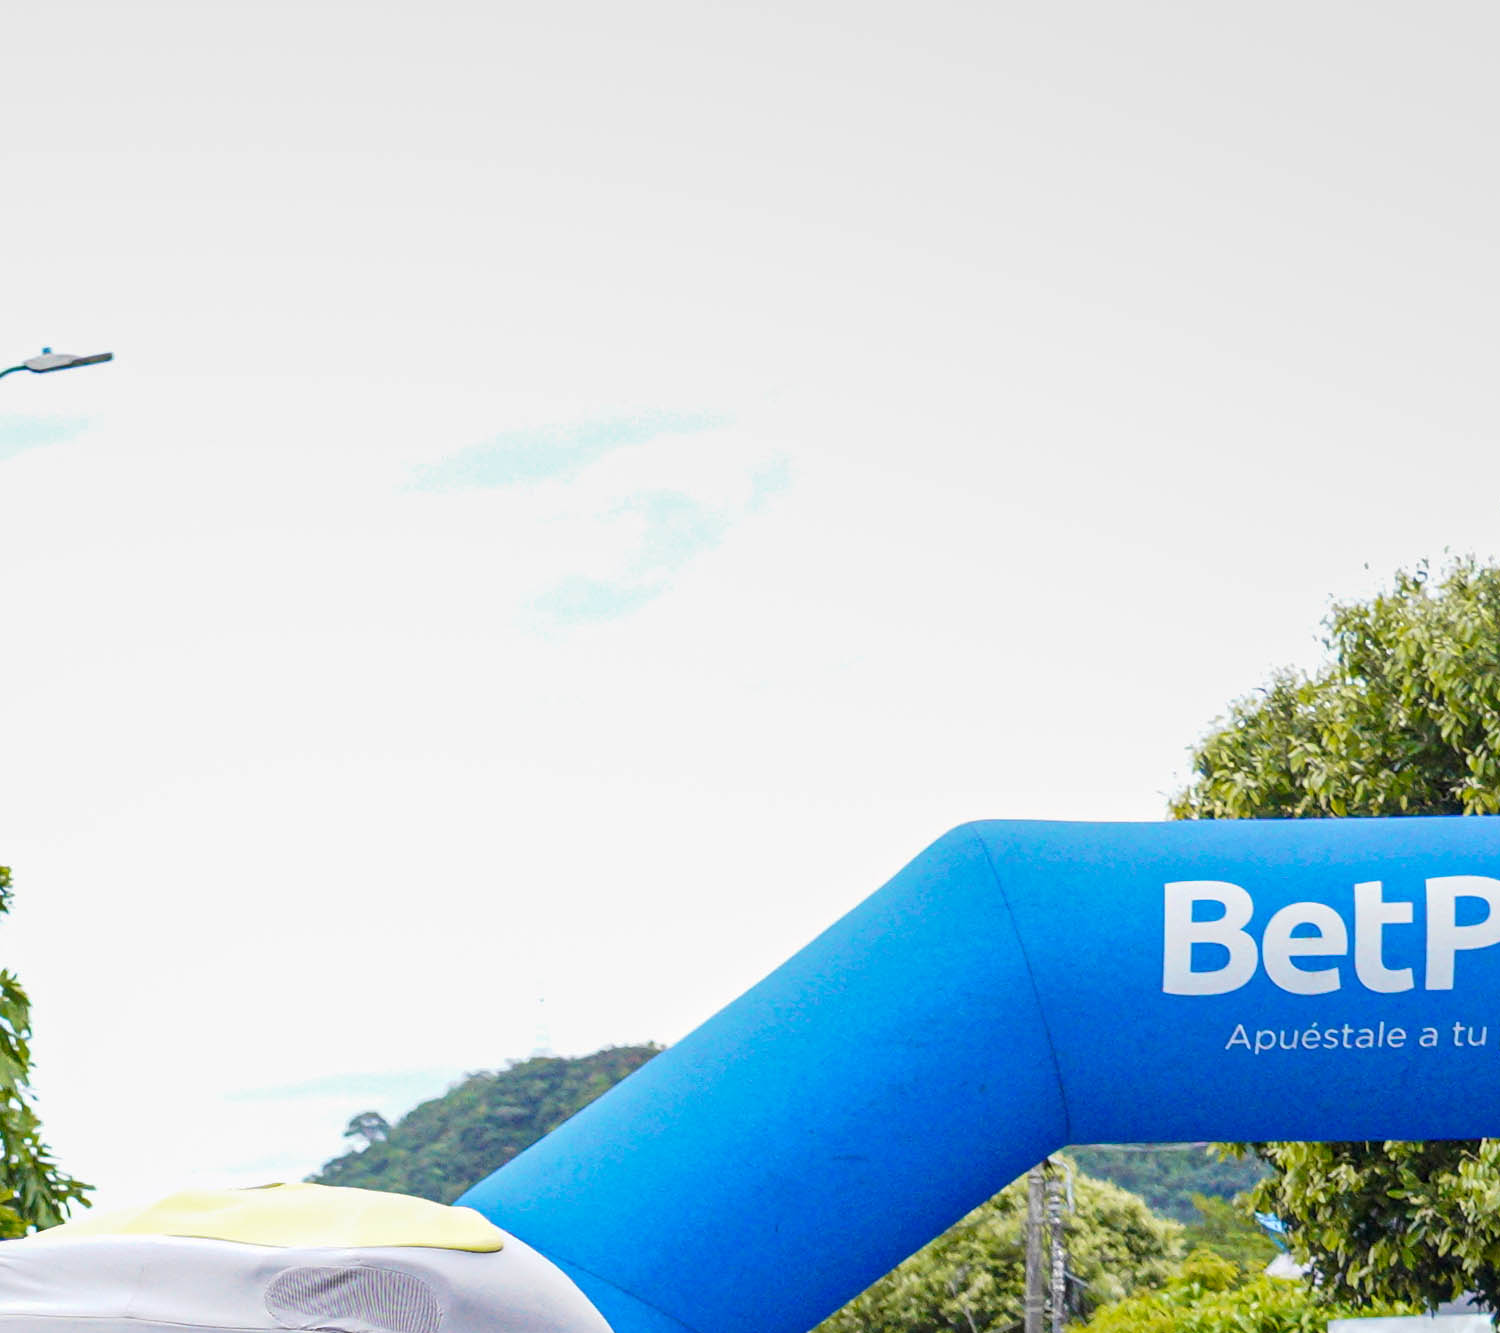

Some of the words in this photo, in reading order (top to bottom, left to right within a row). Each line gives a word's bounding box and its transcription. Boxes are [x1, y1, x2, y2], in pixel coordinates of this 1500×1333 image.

[1225, 1021, 1406, 1054] Apuéstale
[1420, 1028, 1437, 1047] a
[1454, 1022, 1486, 1047] tu
